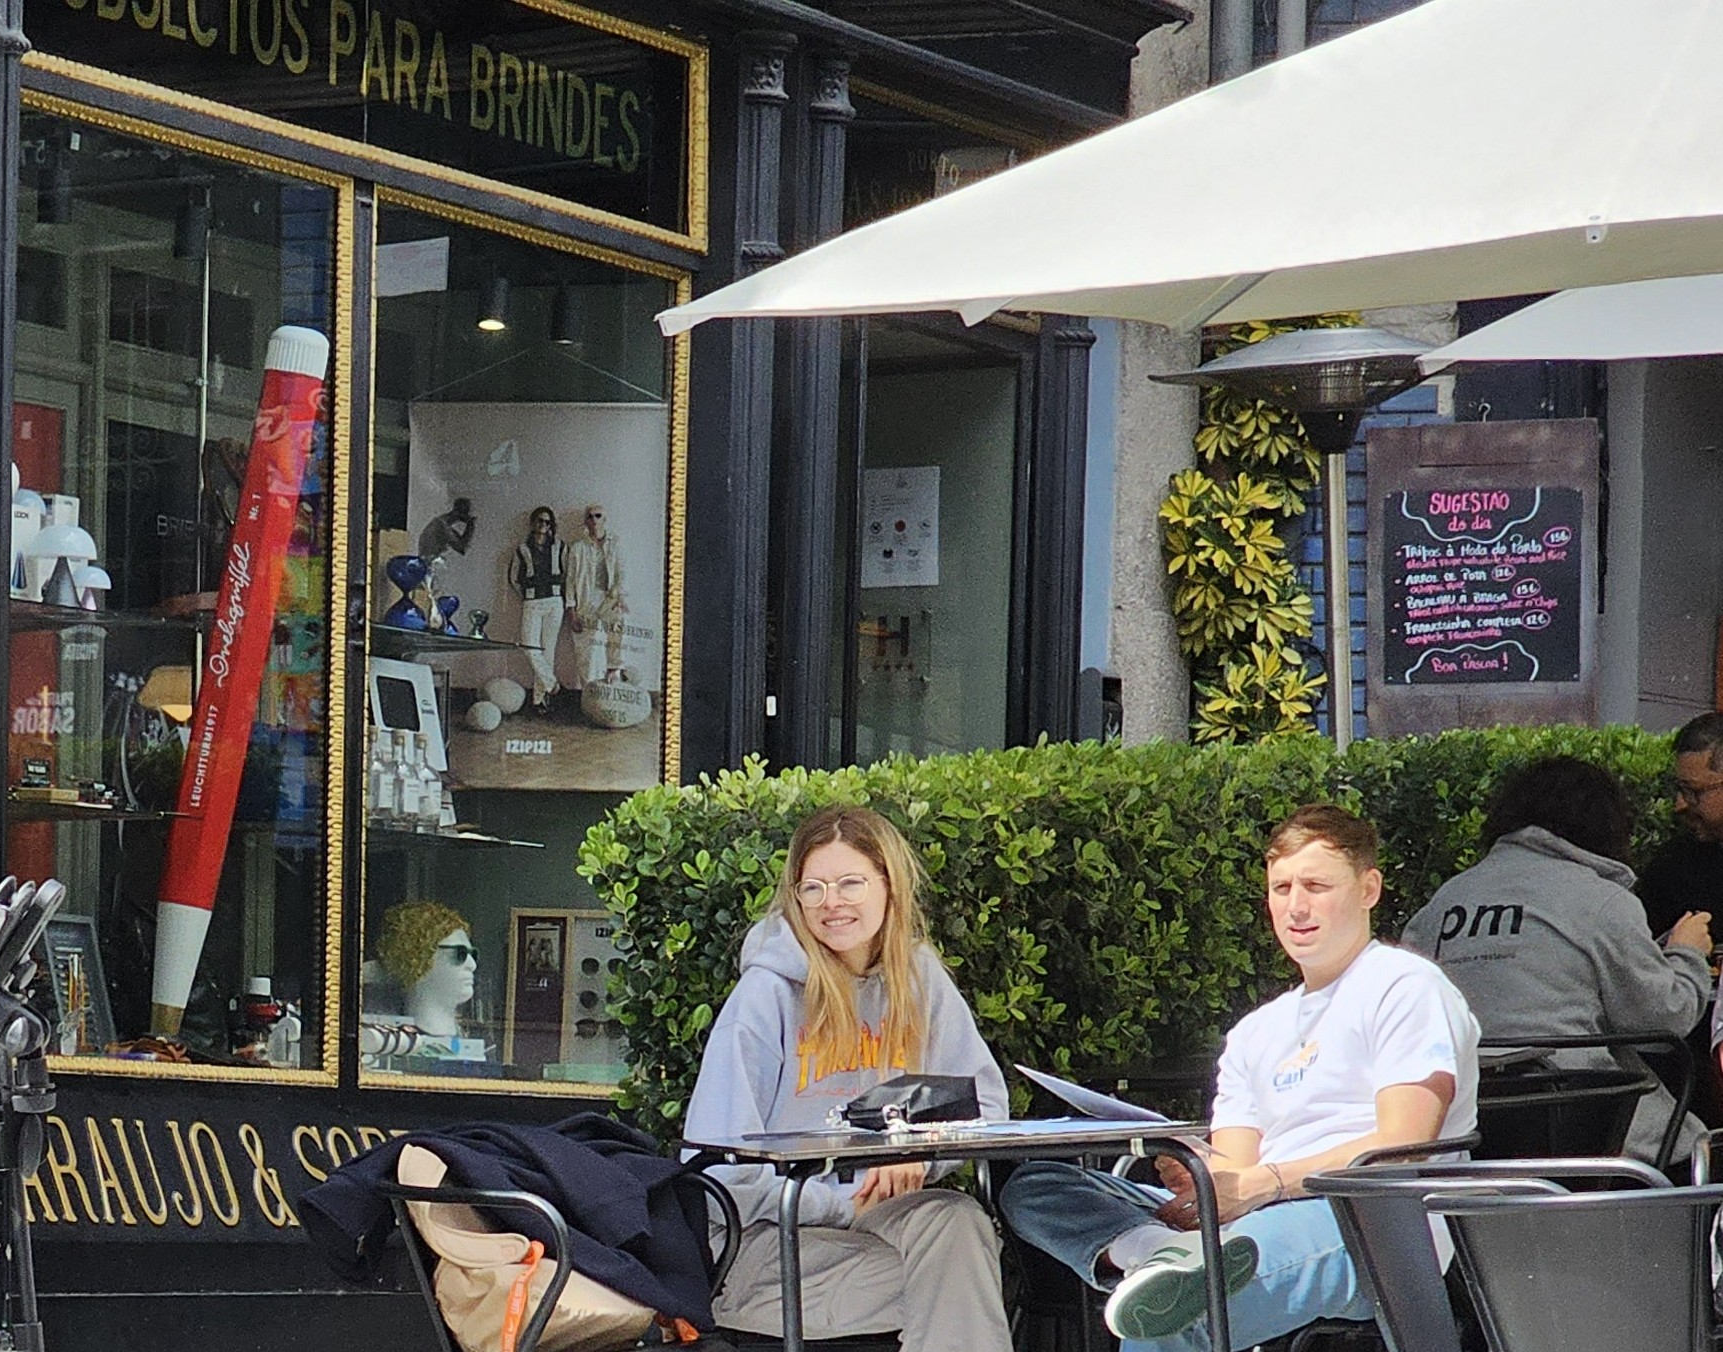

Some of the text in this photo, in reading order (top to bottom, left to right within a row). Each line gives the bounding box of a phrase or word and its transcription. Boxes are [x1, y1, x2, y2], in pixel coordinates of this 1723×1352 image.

[329, 0, 452, 121] PARA
[470, 43, 641, 173] BRINDES
[1429, 490, 1510, 515] SUGESTÃO
[1447, 515, 1492, 532] do dia
[190, 704, 220, 808] LEUCHTTURM1917
[505, 738, 553, 755] IZIPIZI
[1435, 904, 1524, 961] pm
[239, 1122, 300, 1227] &
